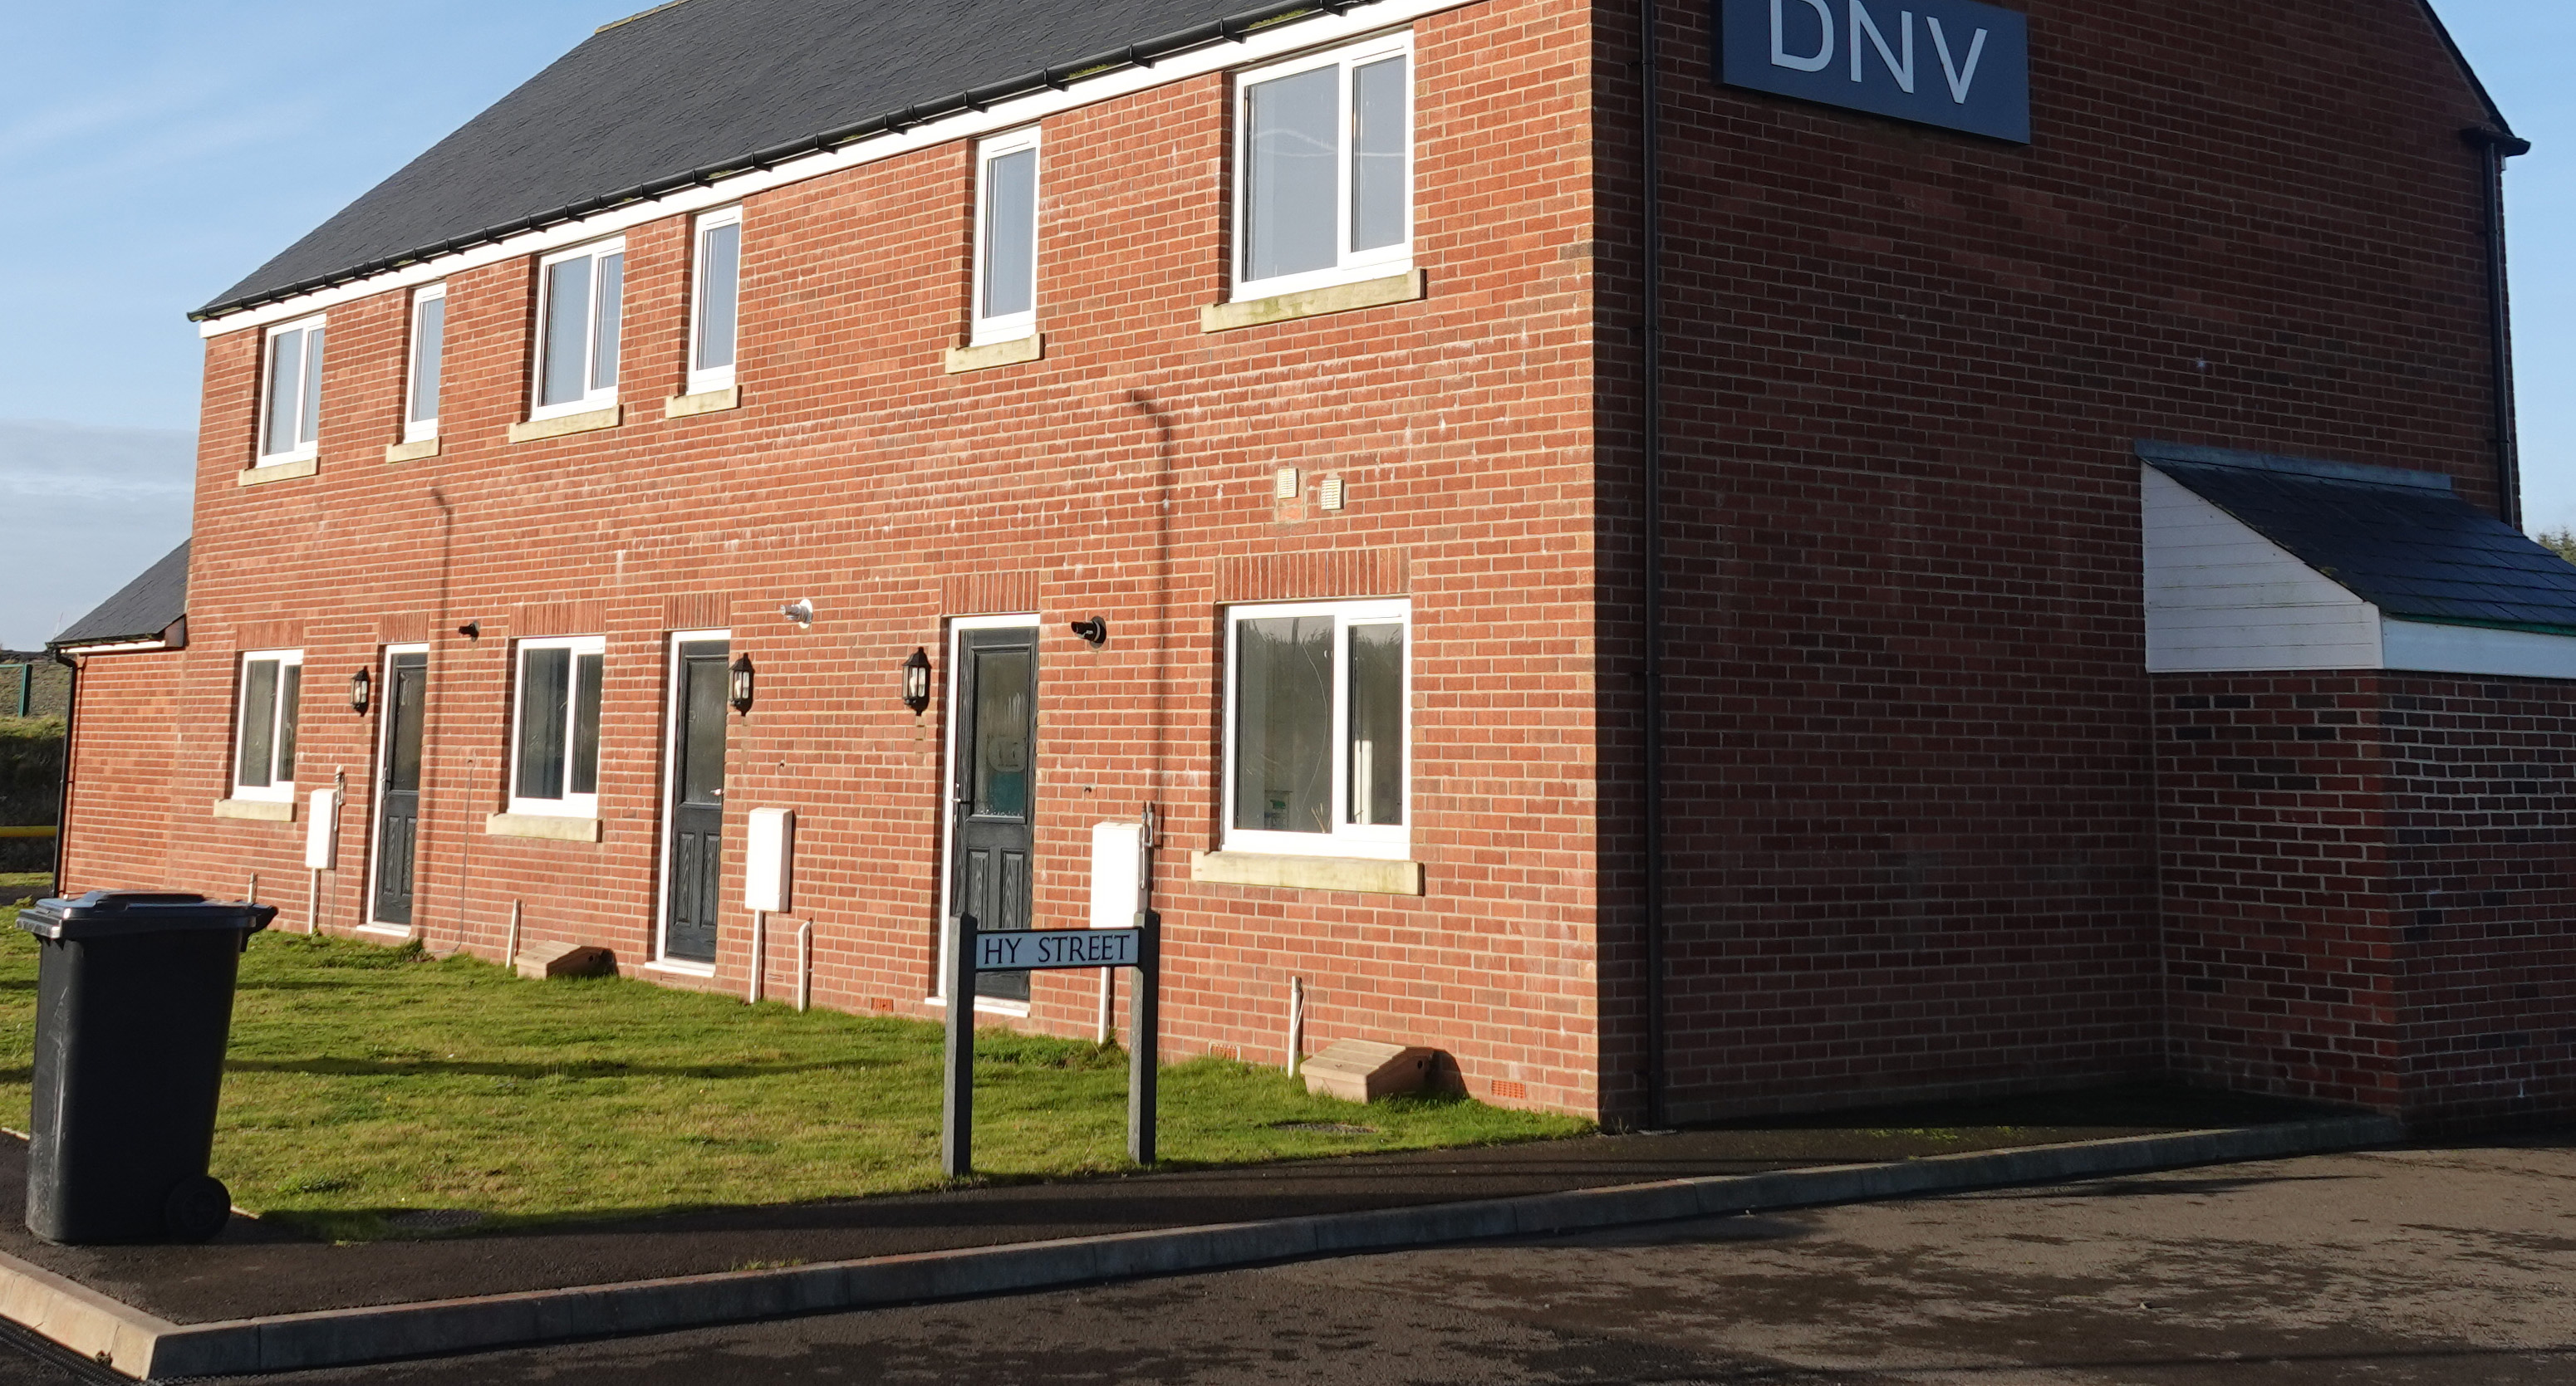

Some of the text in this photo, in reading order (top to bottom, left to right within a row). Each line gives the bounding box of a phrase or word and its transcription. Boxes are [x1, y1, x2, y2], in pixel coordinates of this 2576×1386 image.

[1769, 0, 1988, 105] DNV
[984, 934, 1131, 964] HY STREET
